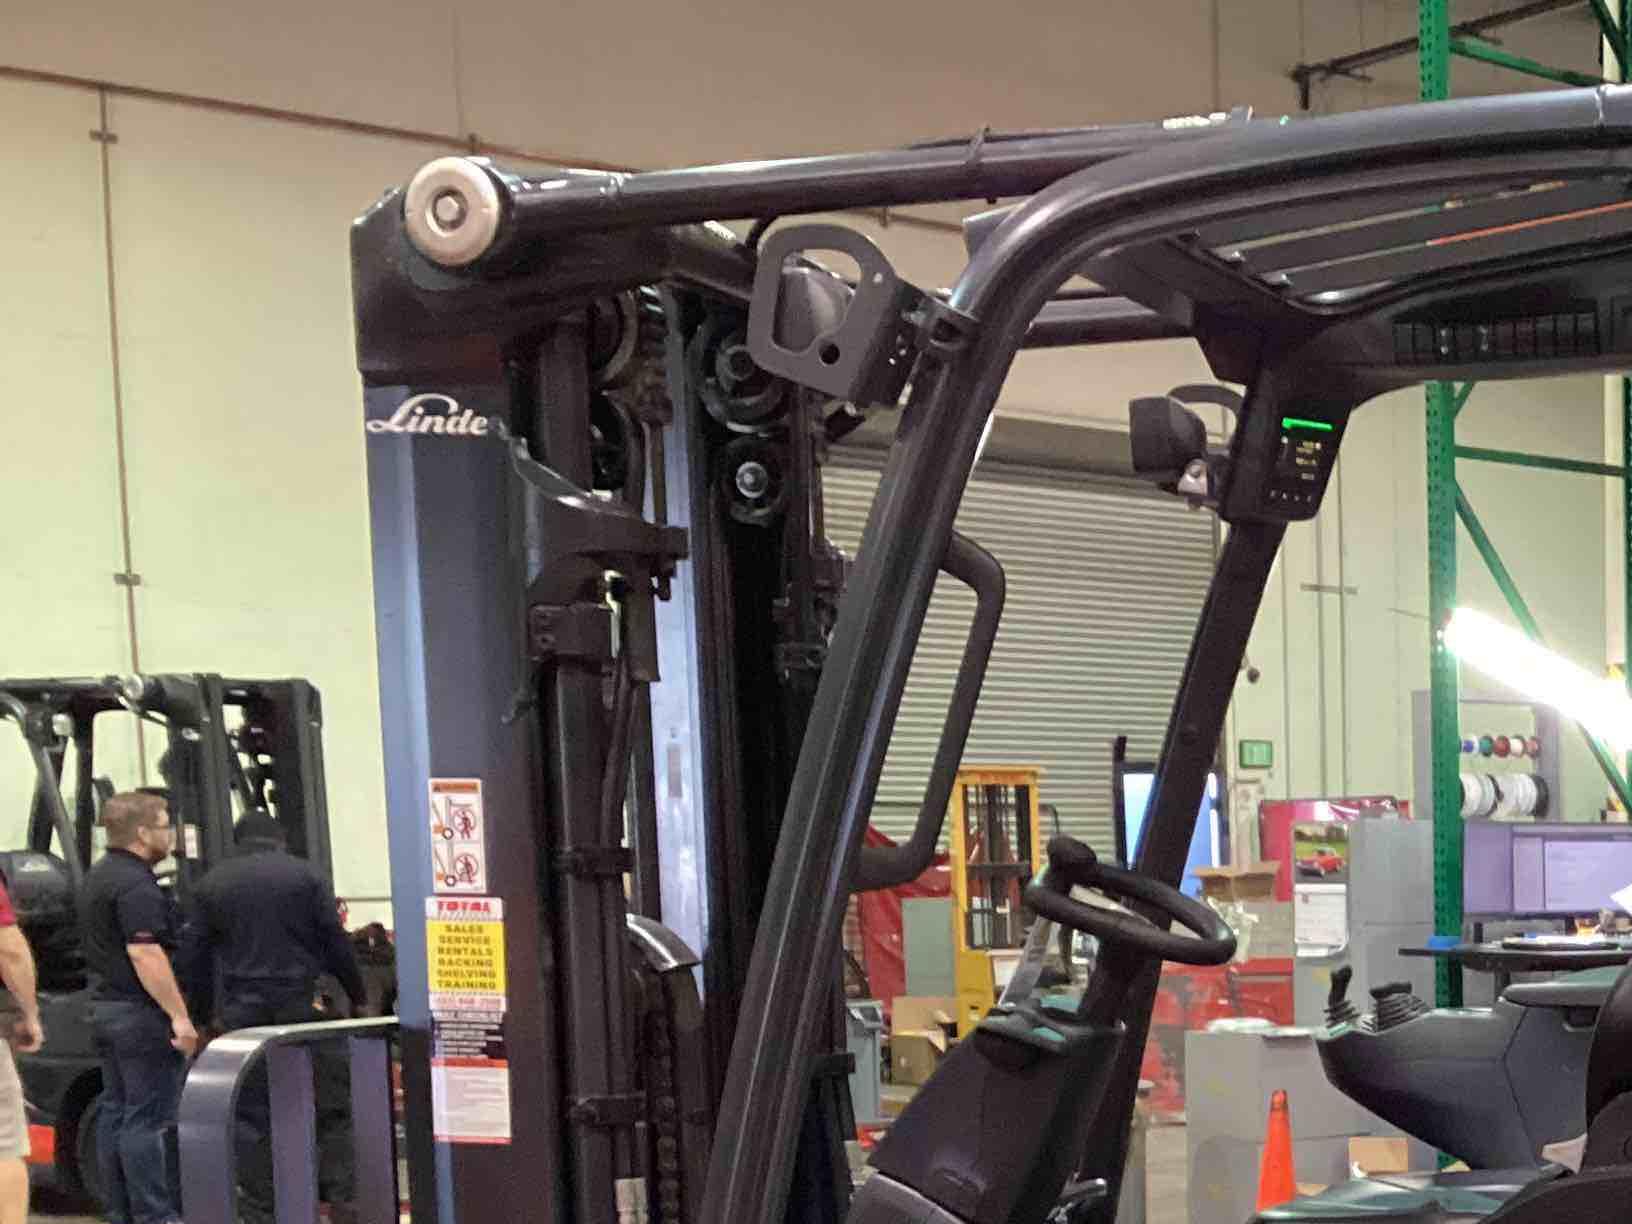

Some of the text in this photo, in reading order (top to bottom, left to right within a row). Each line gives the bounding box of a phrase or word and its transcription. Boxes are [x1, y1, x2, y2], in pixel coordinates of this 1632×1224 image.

[366, 393, 488, 435] Linde
[437, 900, 491, 913] TOTAL
[445, 923, 484, 934] SALES
[438, 935, 491, 945] SERVICE
[437, 946, 493, 957] RENTALS
[438, 957, 493, 968] RACKING
[437, 968, 497, 979] SHELVING
[437, 979, 497, 990] TRAINING
